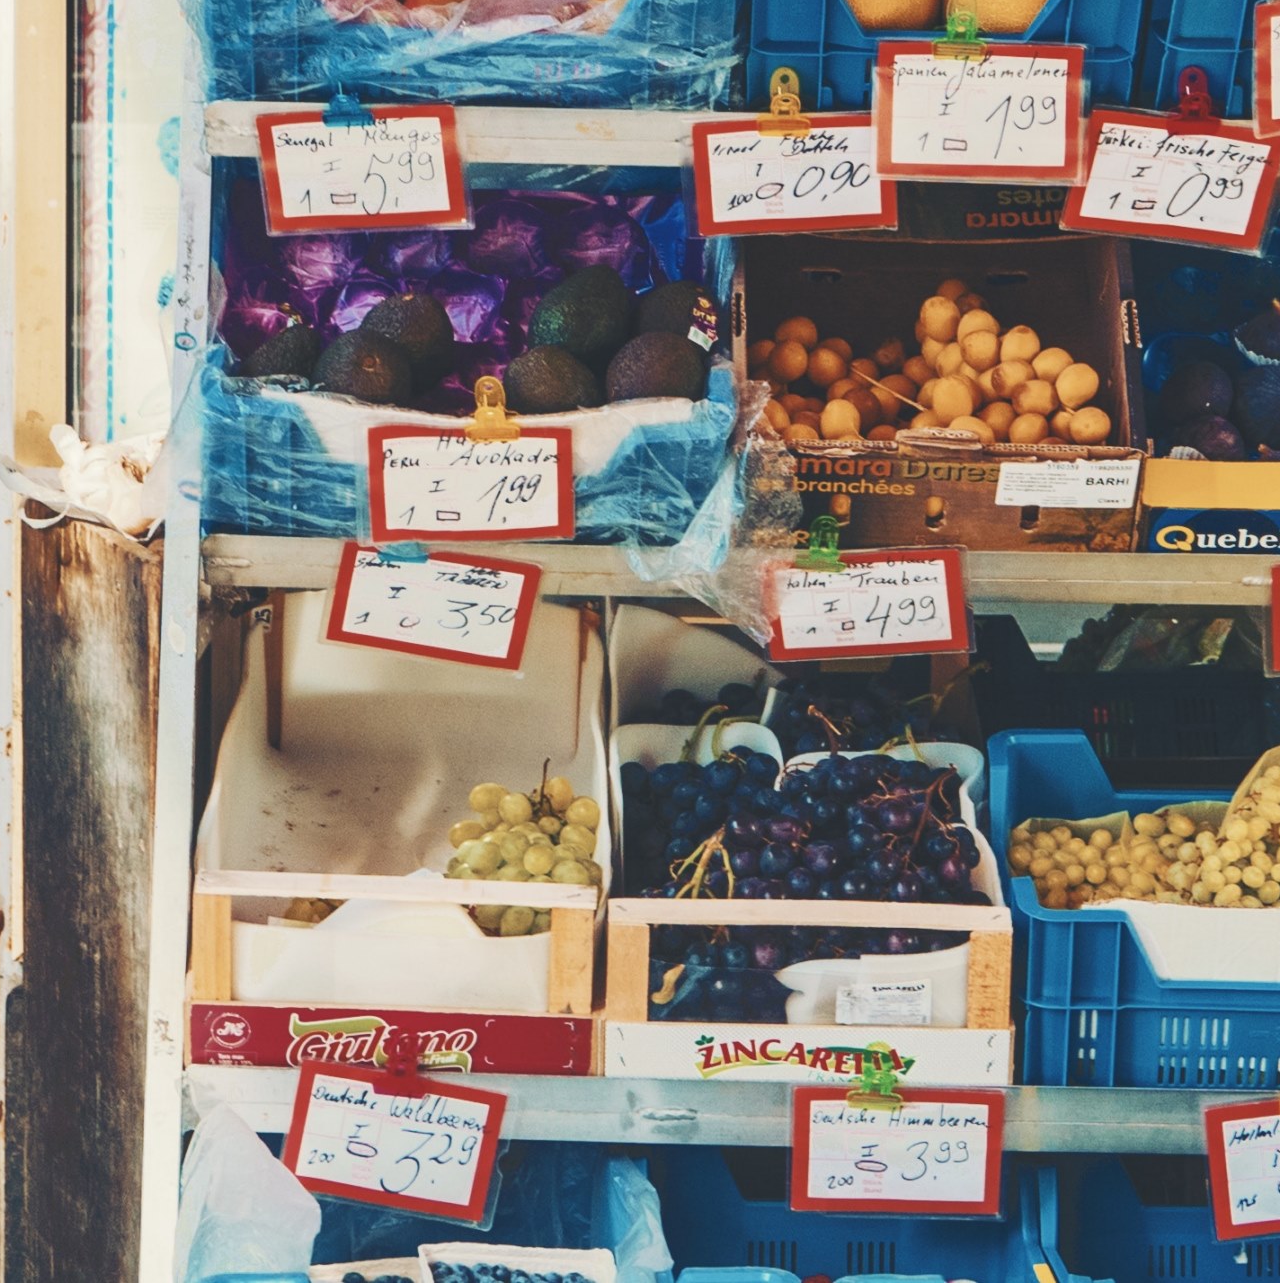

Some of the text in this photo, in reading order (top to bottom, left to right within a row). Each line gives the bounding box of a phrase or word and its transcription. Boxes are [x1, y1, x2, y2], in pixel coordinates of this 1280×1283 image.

[275, 131, 334, 153] Senegal
[299, 188, 312, 214] 1
[1109, 192, 1122, 210] 1
[901, 460, 1000, 483] Dates
[1085, 476, 1131, 487] BARHI
[793, 476, 915, 496] branchées
[399, 506, 415, 525] 1
